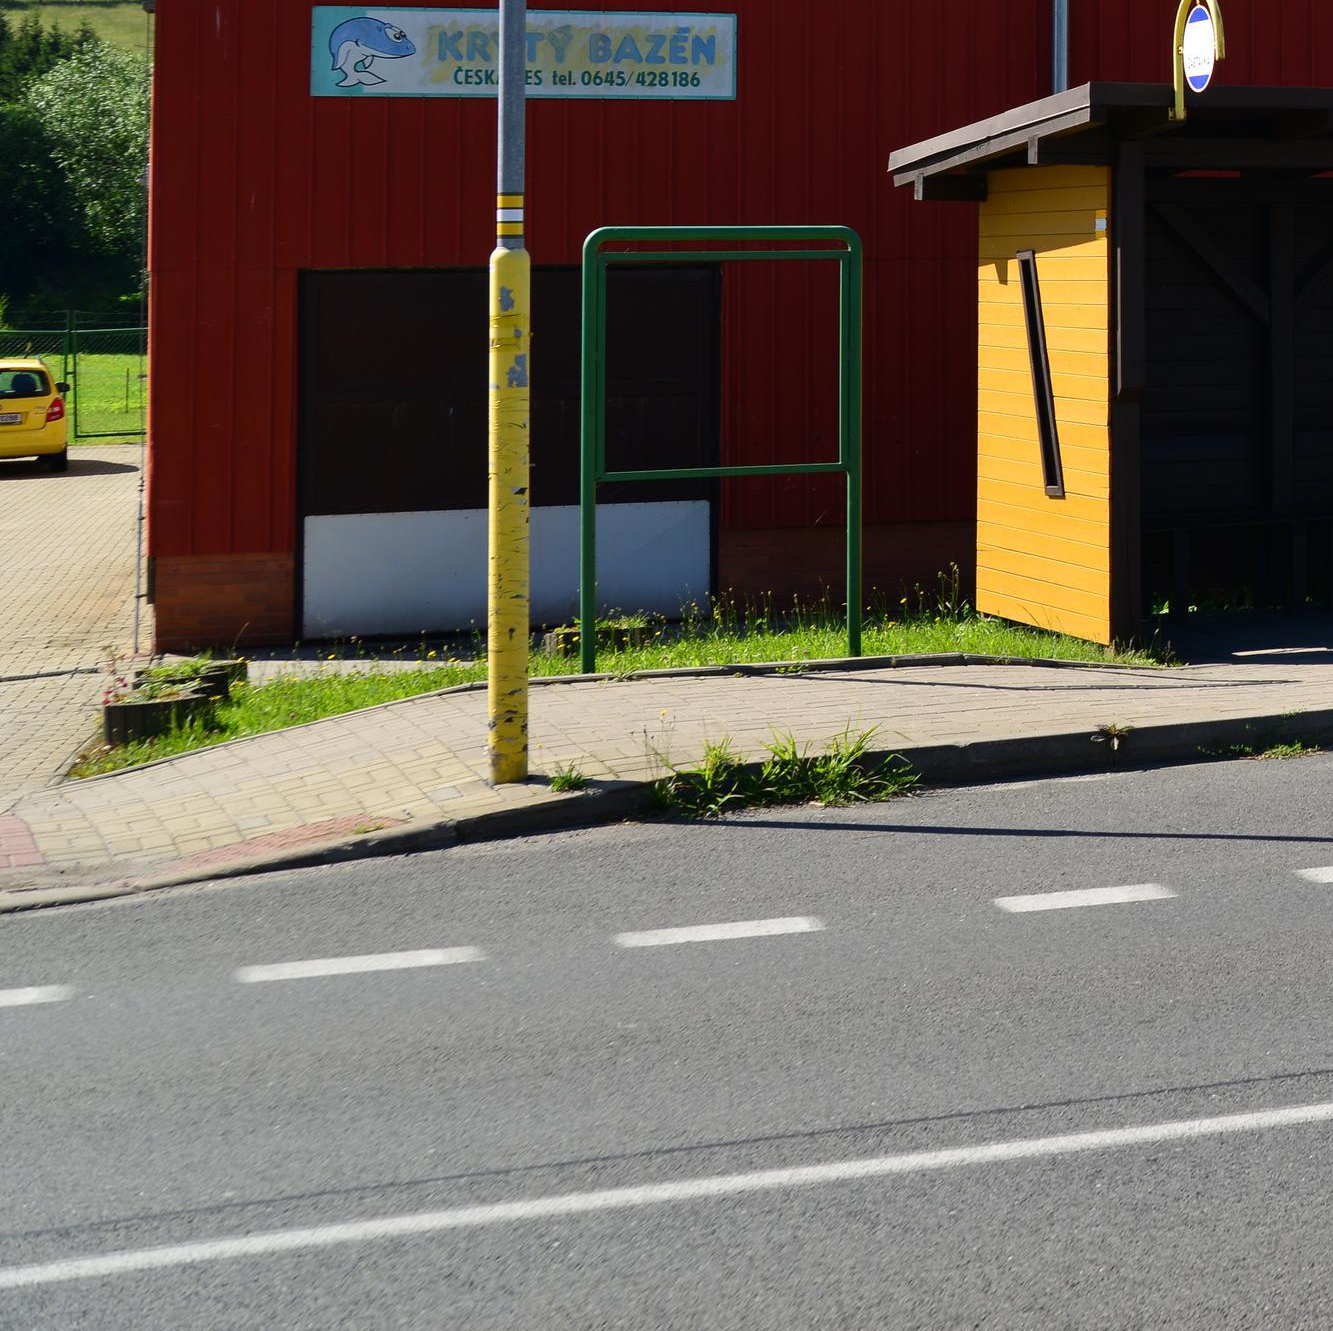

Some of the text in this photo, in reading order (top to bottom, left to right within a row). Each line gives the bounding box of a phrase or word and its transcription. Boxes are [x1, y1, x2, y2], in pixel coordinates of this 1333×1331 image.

[437, 25, 716, 65] KRTÝ BAZÉN
[453, 66, 501, 86] ČESK
[552, 71, 577, 87] tel.
